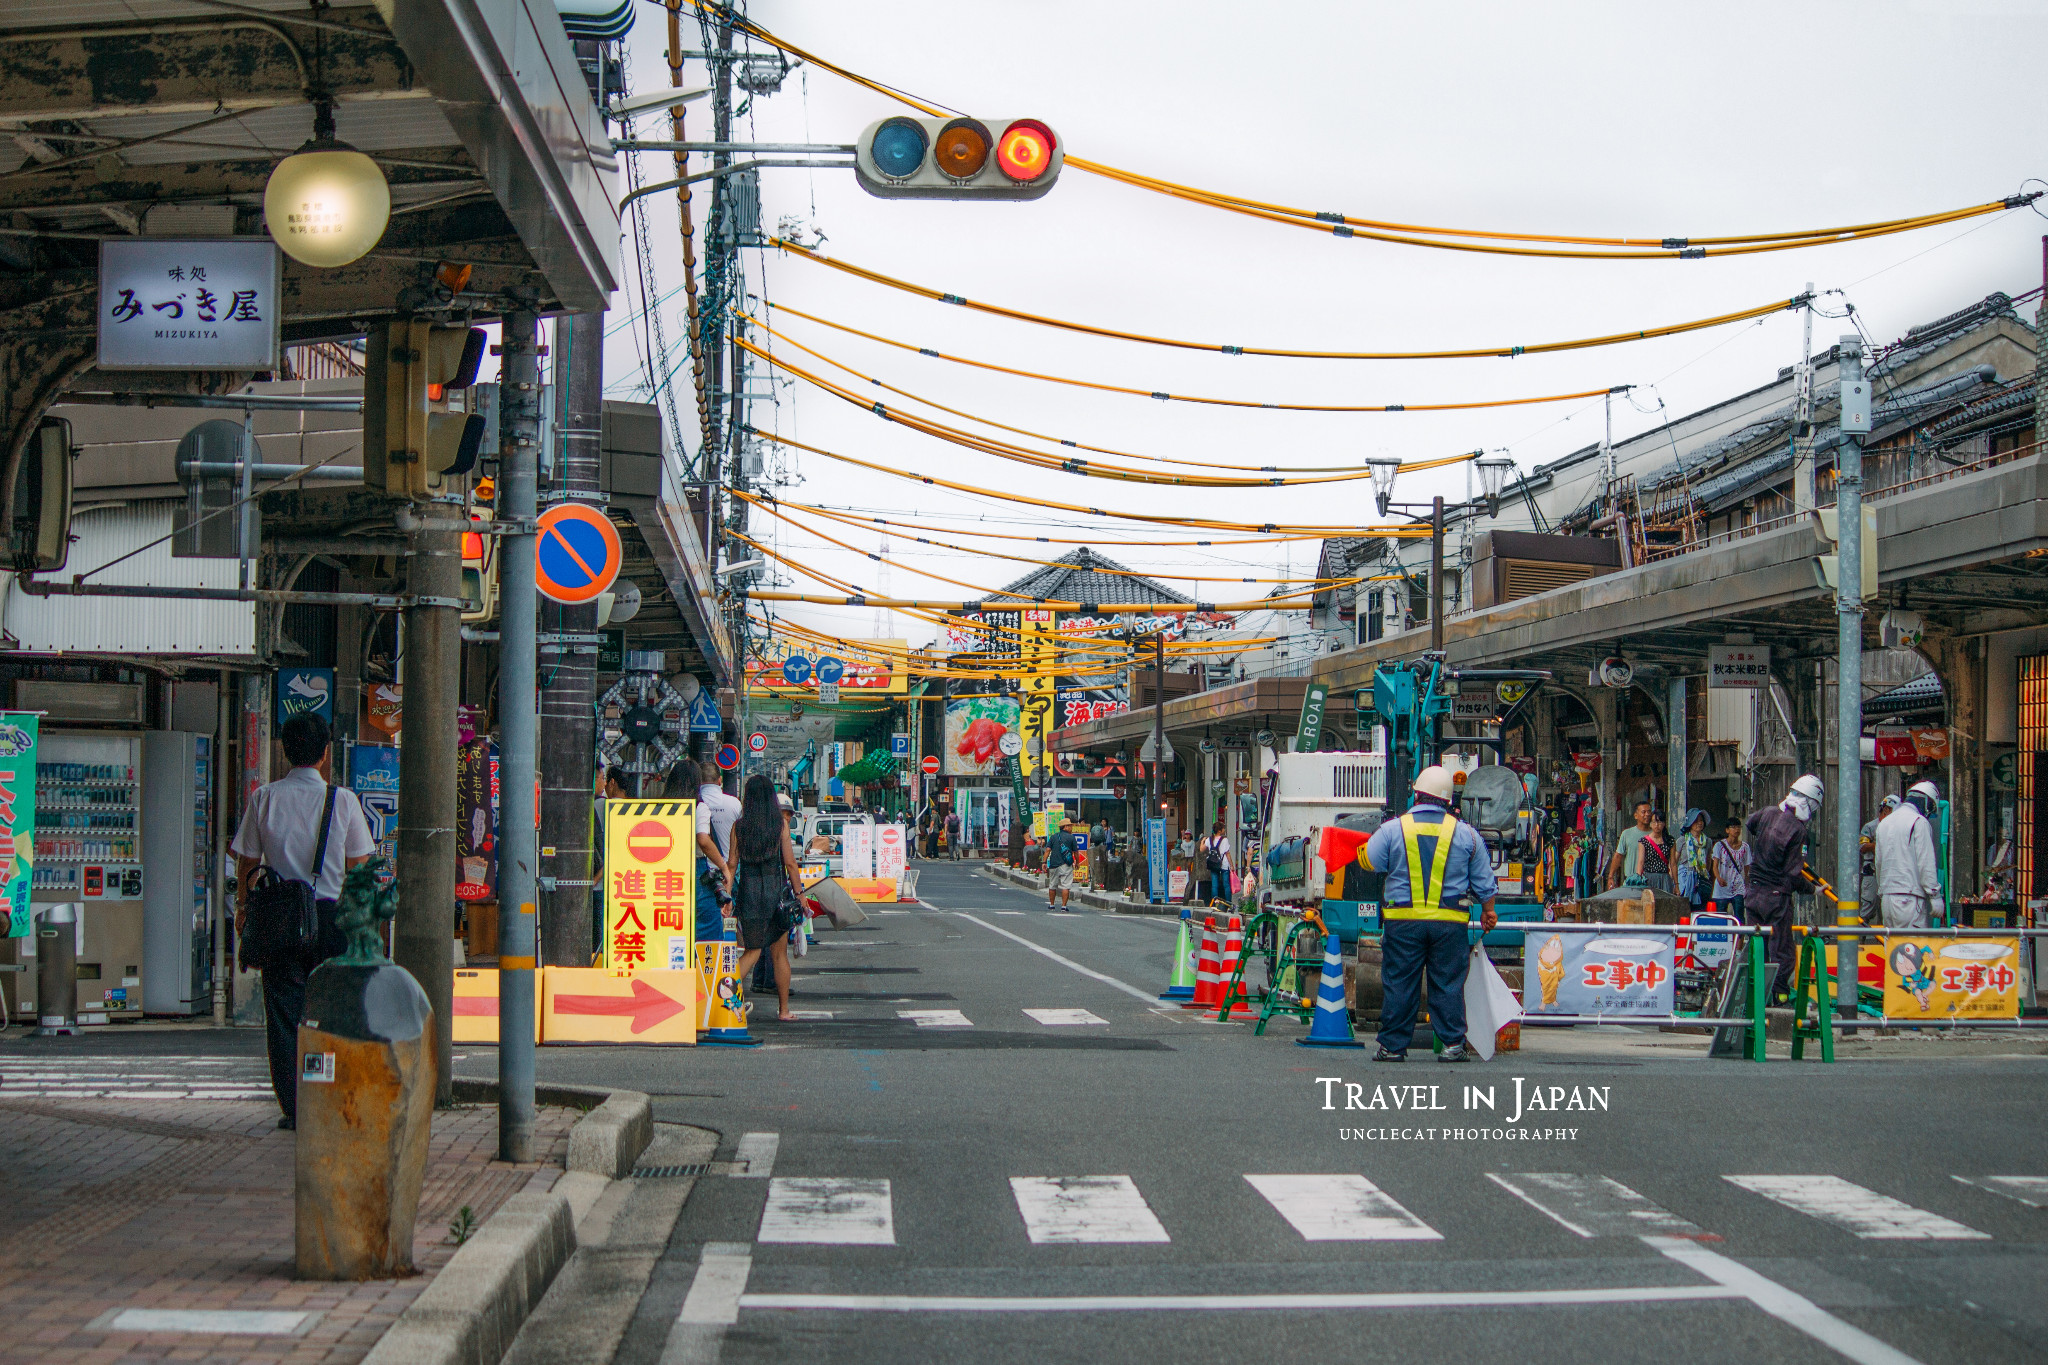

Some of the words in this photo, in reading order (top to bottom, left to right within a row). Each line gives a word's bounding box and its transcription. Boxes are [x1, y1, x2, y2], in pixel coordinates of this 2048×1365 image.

[168, 266, 207, 282] 味処
[111, 287, 262, 324] みづき屋
[154, 330, 218, 339] MIZUKIYA
[1713, 663, 1767, 675] 秋本米穀店
[282, 695, 322, 715] Welcome
[1303, 690, 1323, 738] ROAD
[752, 738, 764, 747] 40
[896, 738, 906, 751] P
[1018, 796, 1028, 816] ROAD
[891, 847, 902, 866] 車両
[652, 869, 685, 931] 車両
[722, 945, 731, 973] 境港市
[1583, 959, 1666, 990] 工事中
[1942, 964, 2014, 993] 工事中
[1605, 1000, 1658, 1009] 安全衛生協議会
